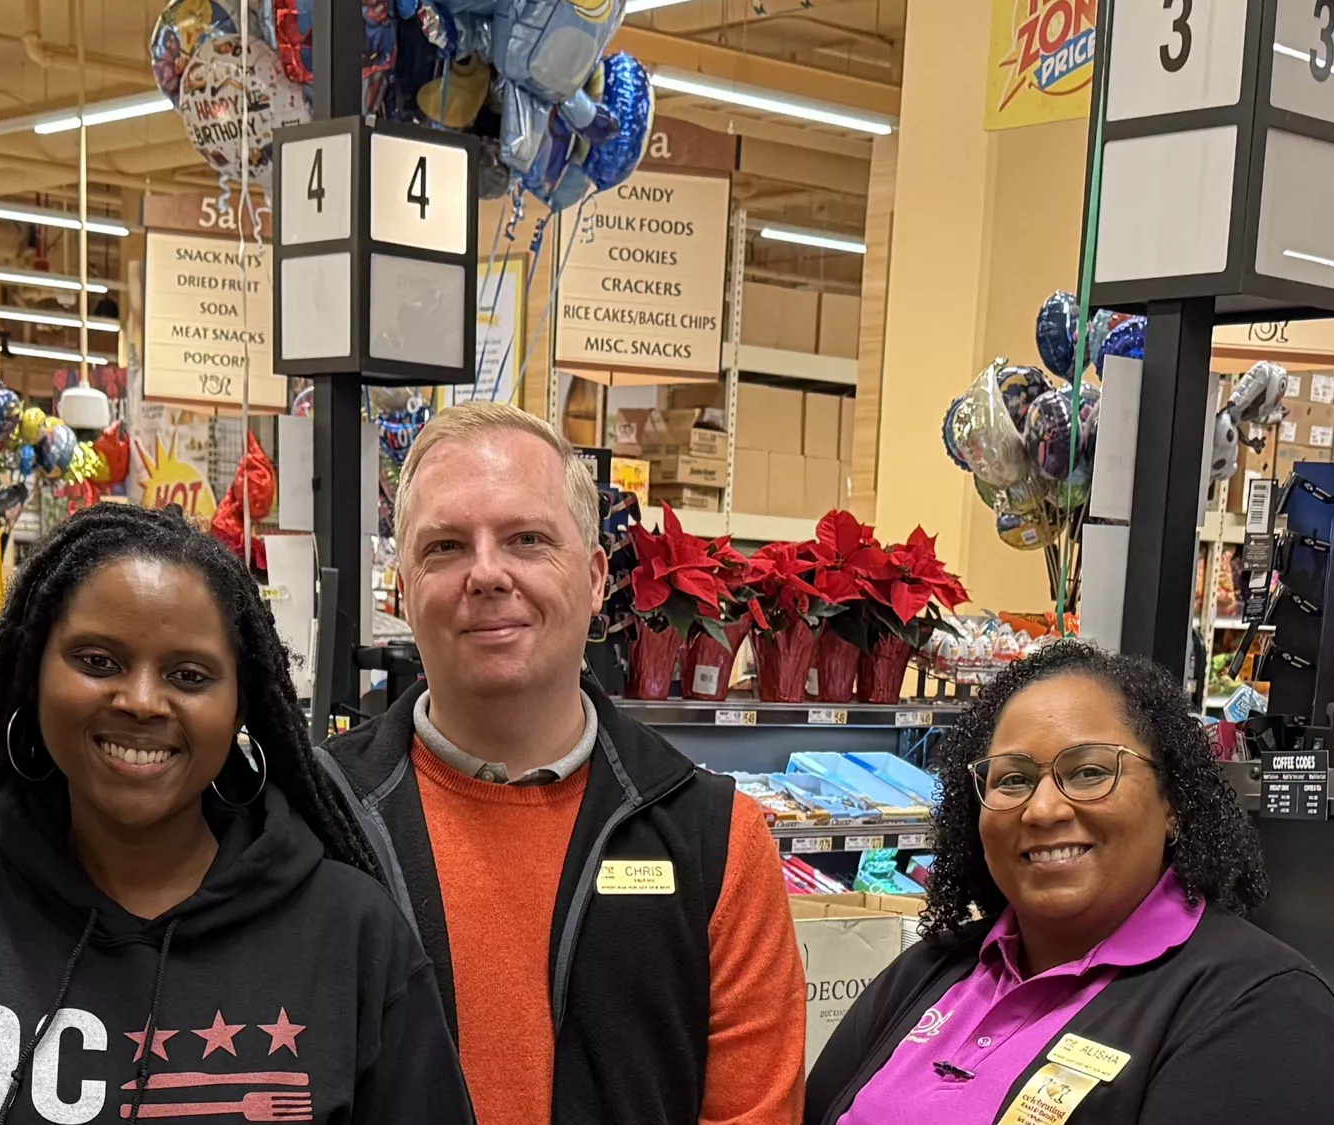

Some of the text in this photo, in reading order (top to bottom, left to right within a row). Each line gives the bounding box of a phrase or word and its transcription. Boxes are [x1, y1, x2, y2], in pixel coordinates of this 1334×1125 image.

[1017, 0, 1097, 75] ZON
[1160, 0, 1192, 72] 3
[1041, 30, 1095, 86] PRICE
[194, 95, 239, 121] HAPPY
[193, 117, 257, 146] BIRTHDAY
[650, 131, 671, 158] a
[307, 148, 325, 213] 4
[406, 155, 430, 220] 4
[617, 185, 674, 203] CANDY
[199, 197, 236, 229] 5a
[595, 214, 694, 236] BULK FOODS
[176, 248, 261, 268] SNACK NUTS
[608, 246, 677, 266] COOKIES
[177, 274, 260, 293] DRIED FRUIT
[601, 277, 682, 297] CRACKERS
[200, 302, 238, 317] SODA
[563, 304, 717, 331] RICE CAKES/BAGEL CHIPS
[171, 325, 265, 345] MEAT SNACKS
[584, 337, 692, 359] MISC. SNACKS
[1273, 755, 1316, 769] COFFEE CODES
[625, 866, 663, 877] CHRIS
[1080, 1045, 1120, 1065] ALISHA
[1022, 1093, 1066, 1119] celebrating
